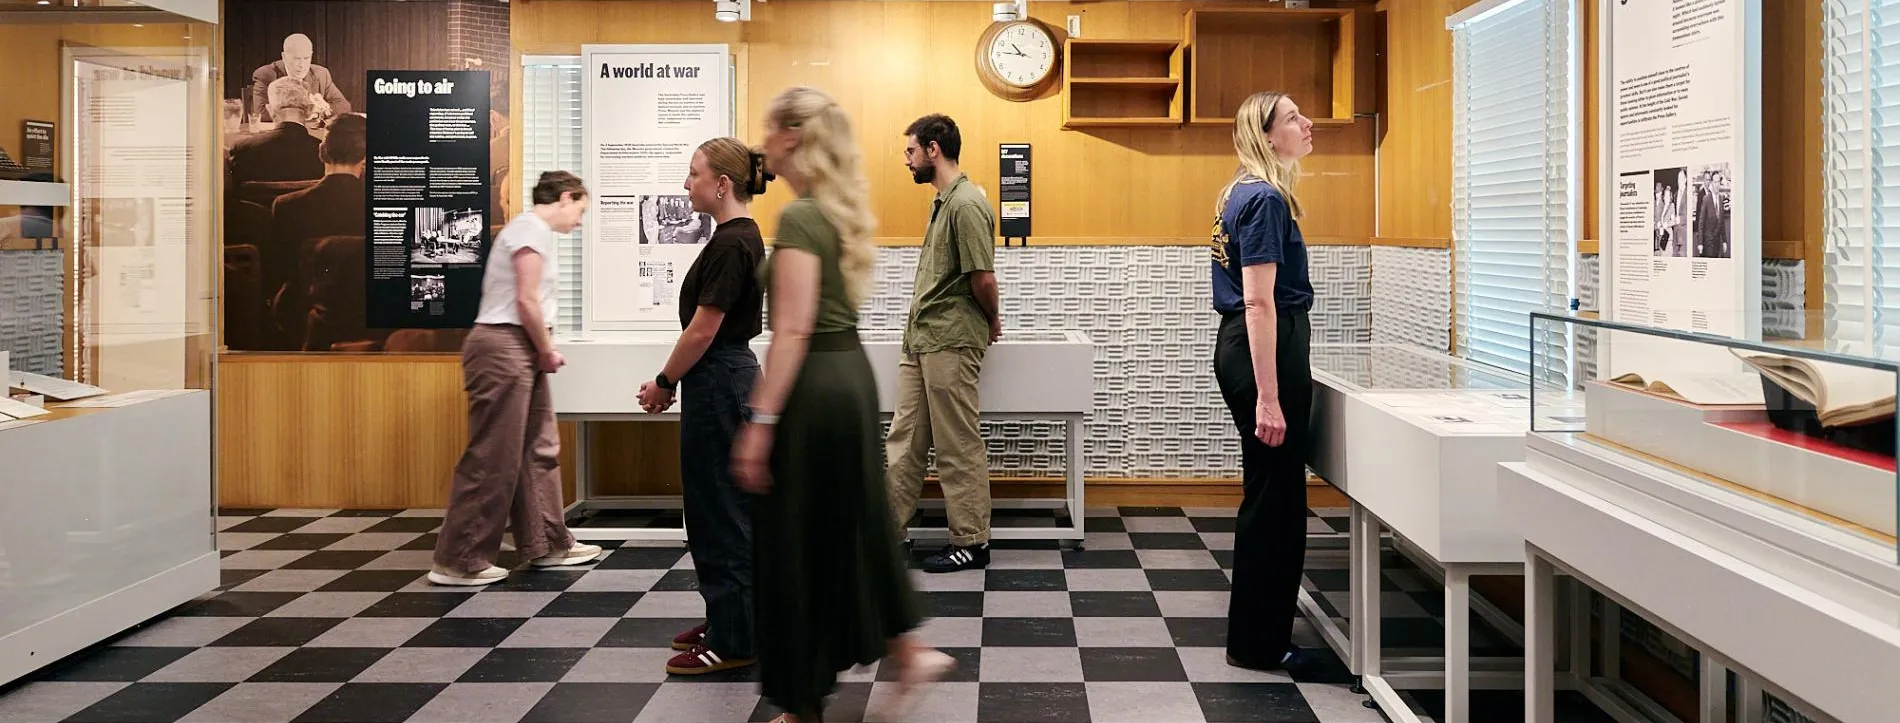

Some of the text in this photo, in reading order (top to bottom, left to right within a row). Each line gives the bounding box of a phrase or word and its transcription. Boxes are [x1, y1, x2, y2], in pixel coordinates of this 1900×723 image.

[1018, 28, 1025, 36] 12
[600, 63, 700, 78] A world at war
[374, 78, 454, 98] Going to air
[1620, 182, 1636, 190] Targeting
[1619, 190, 1637, 199] journalists
